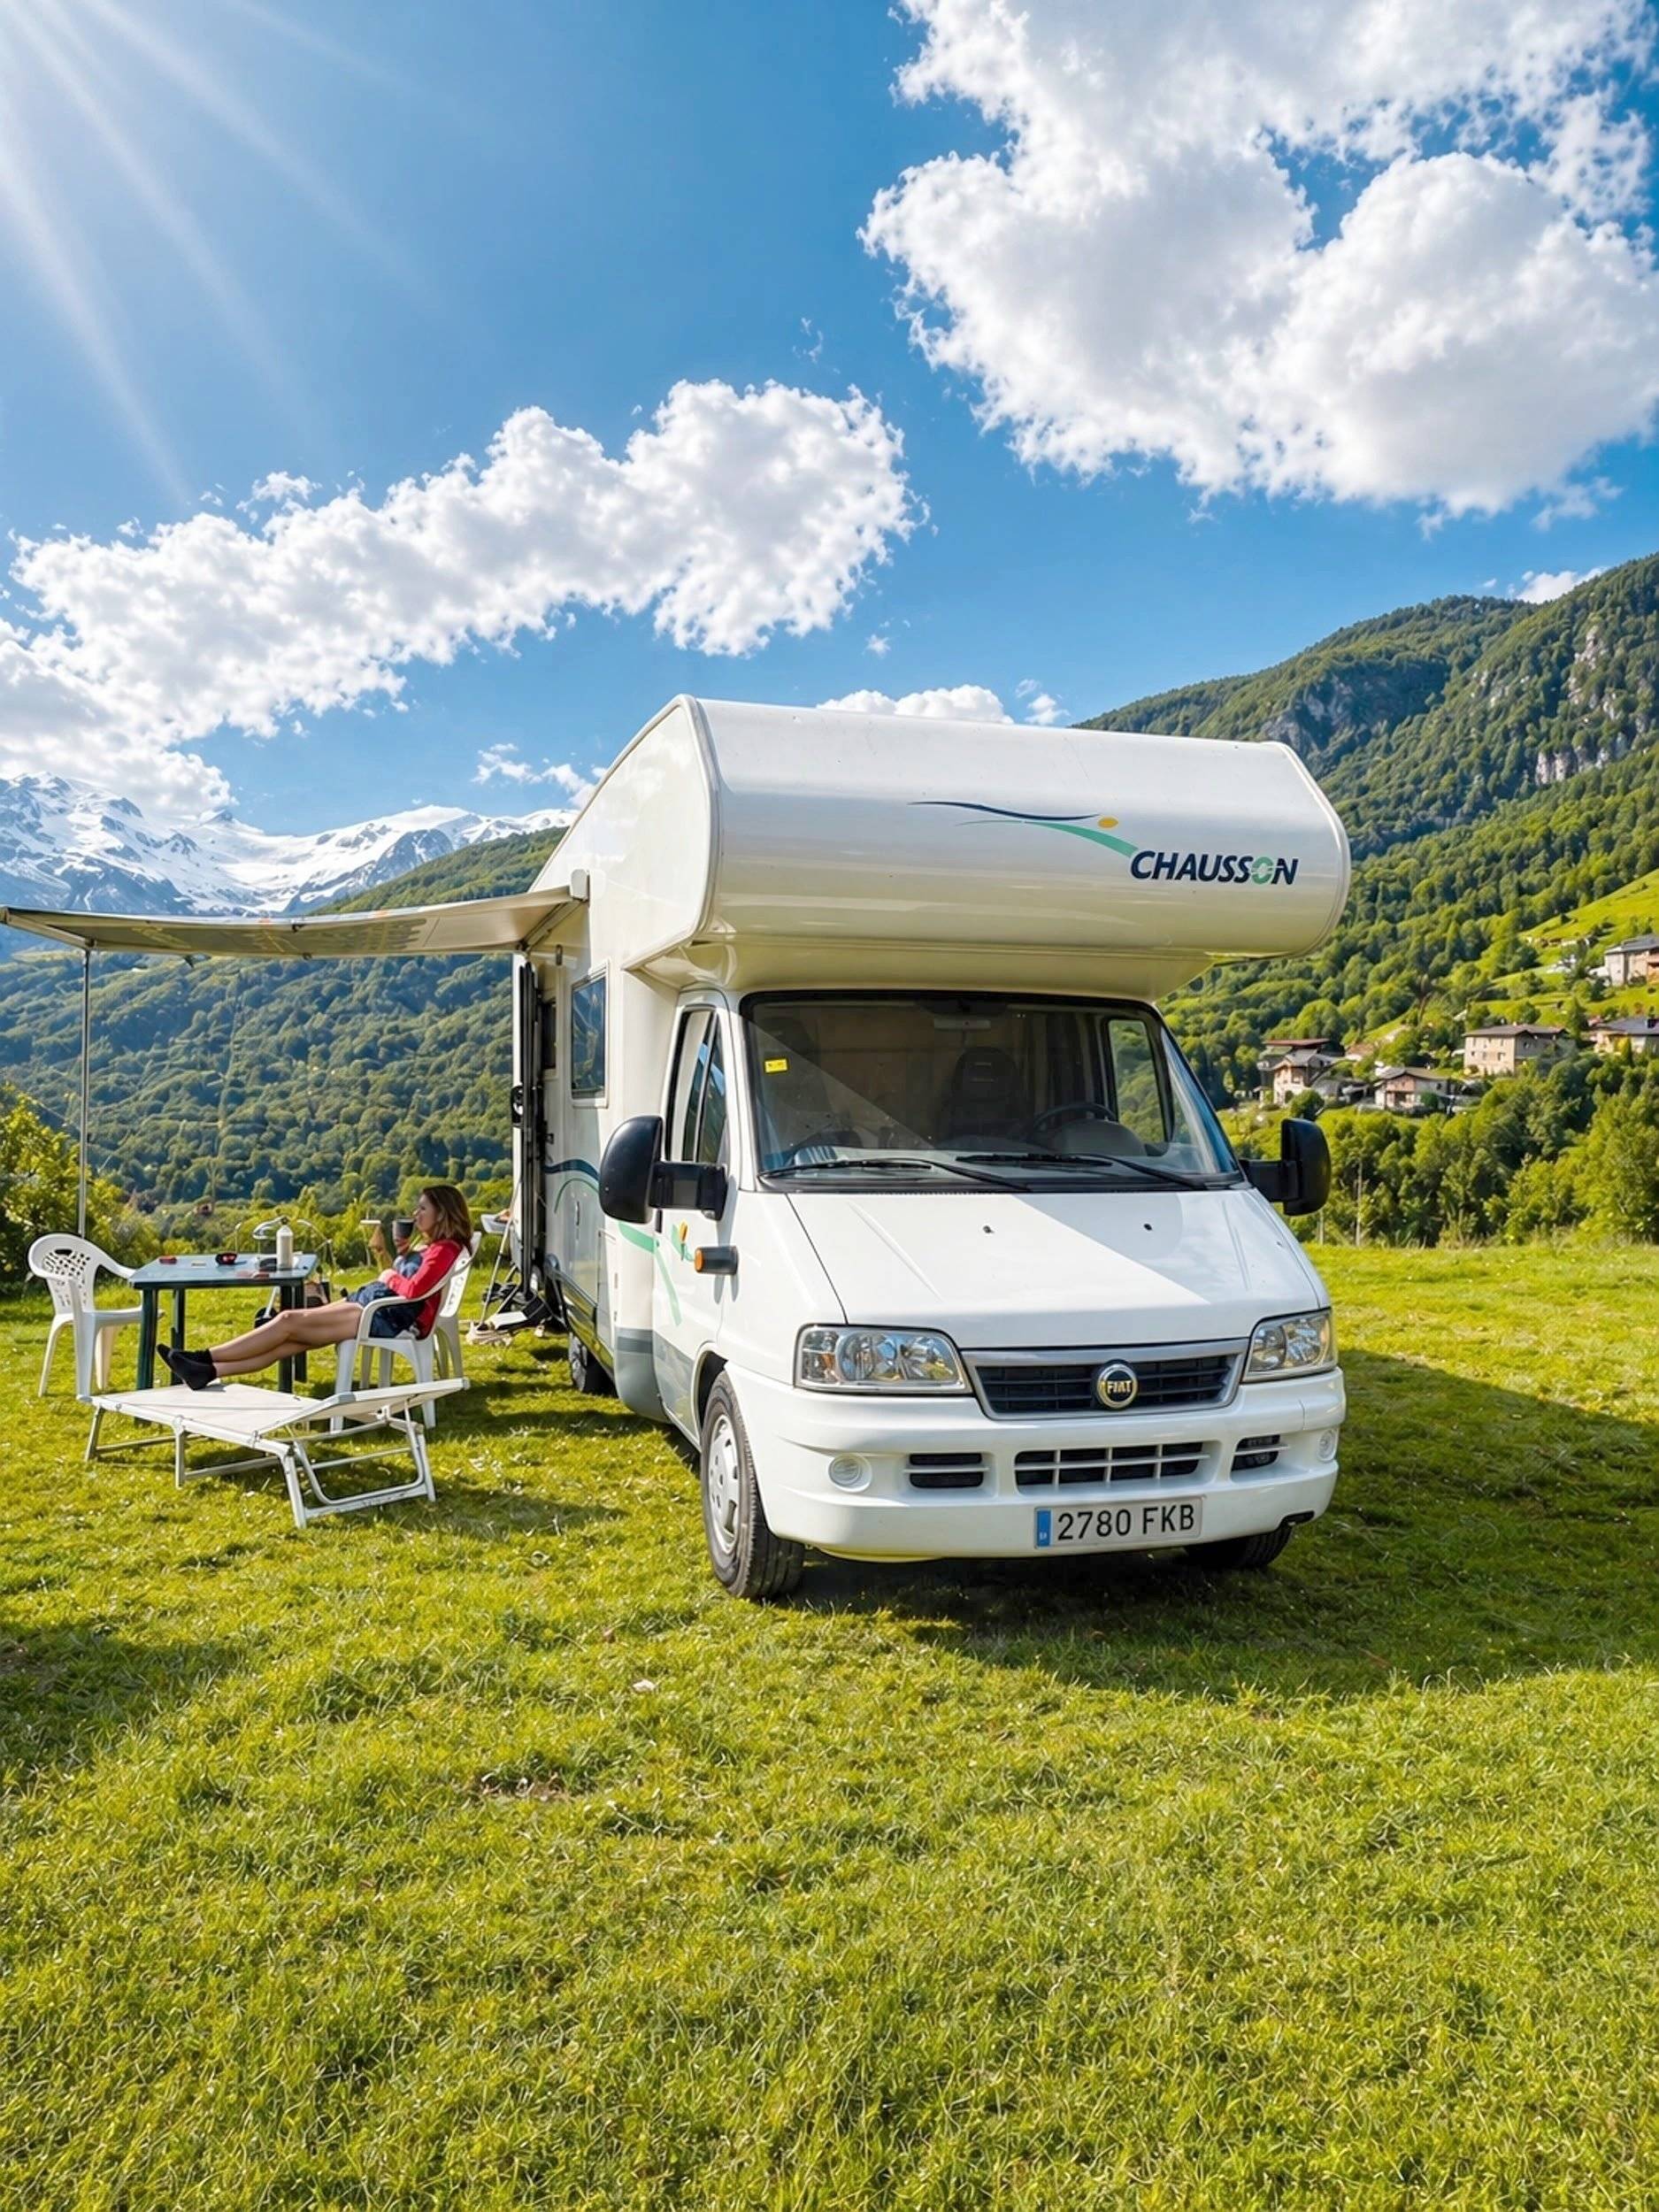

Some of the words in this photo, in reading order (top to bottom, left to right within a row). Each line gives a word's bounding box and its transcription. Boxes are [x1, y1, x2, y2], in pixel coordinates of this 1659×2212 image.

[1130, 850, 1299, 886] CHAUSSON
[1107, 1380, 1132, 1394] FIAT
[1057, 1509, 1132, 1540] 2780
[1142, 1504, 1194, 1534] FKB
